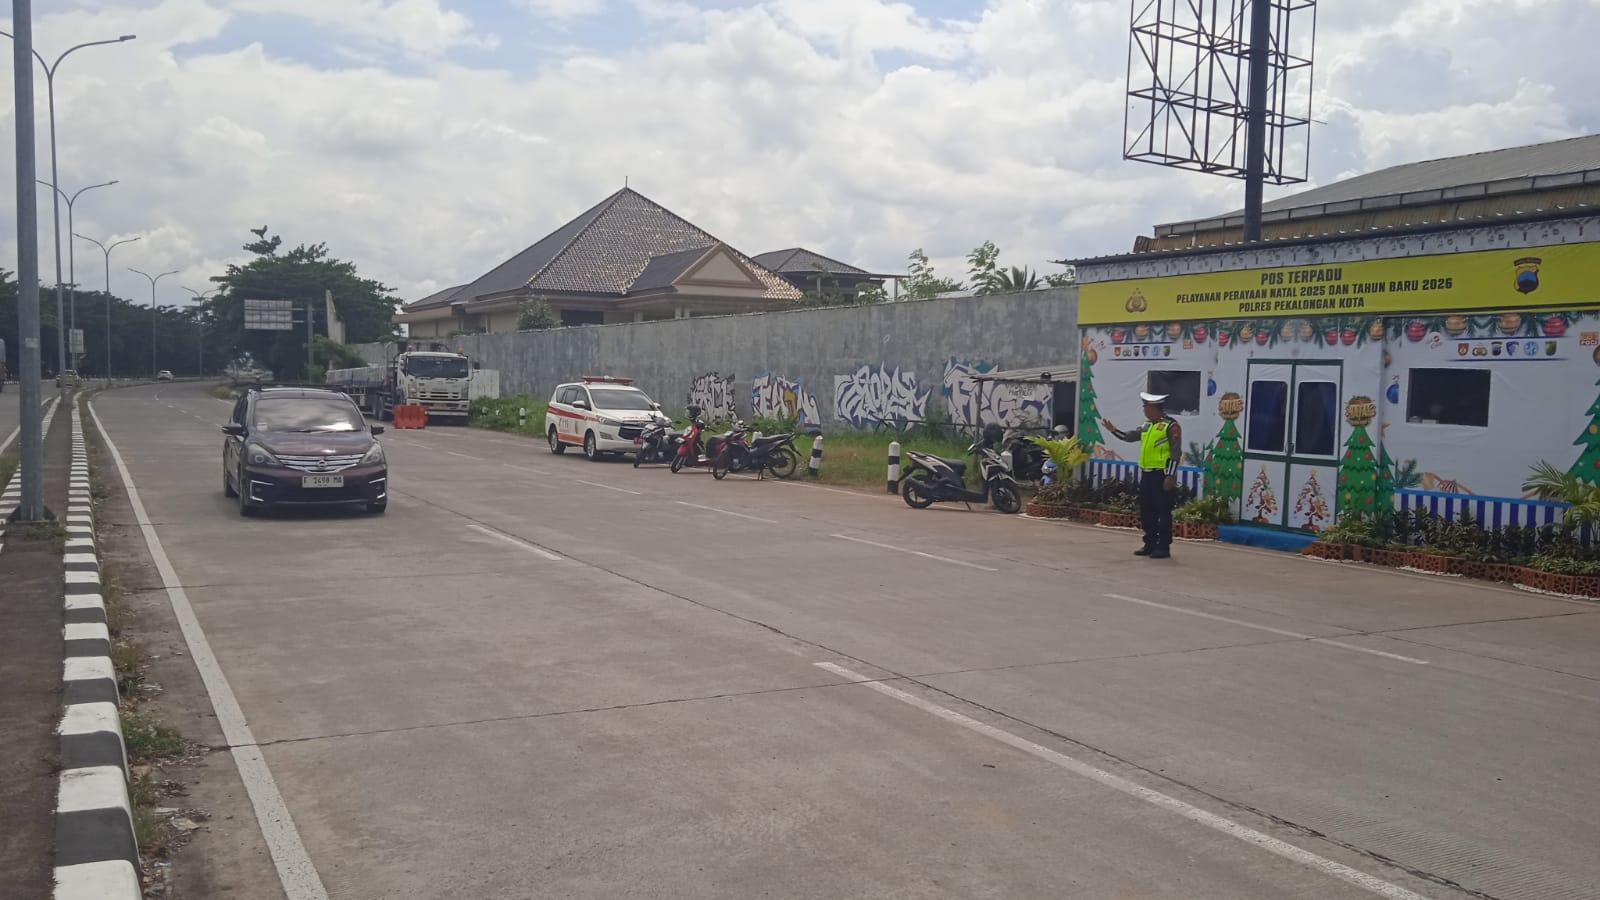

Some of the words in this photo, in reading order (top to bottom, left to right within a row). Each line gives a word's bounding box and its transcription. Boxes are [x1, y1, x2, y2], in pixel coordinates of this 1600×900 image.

[1261, 272, 1284, 285] POS
[1288, 268, 1342, 283] TERPADU
[1176, 293, 1221, 303] PELAYANAN
[1223, 289, 1267, 300] PERAYAAN
[1270, 287, 1297, 298] NATAL
[1300, 285, 1326, 297] 2025
[1328, 284, 1349, 295] DAN
[1352, 281, 1385, 294] TAHUN
[1389, 279, 1418, 292] BARU
[1422, 278, 1453, 290] 2026
[1239, 302, 1271, 312] POLRES
[1274, 298, 1335, 311] PEKALONGAN
[1339, 297, 1365, 308] KOTA
